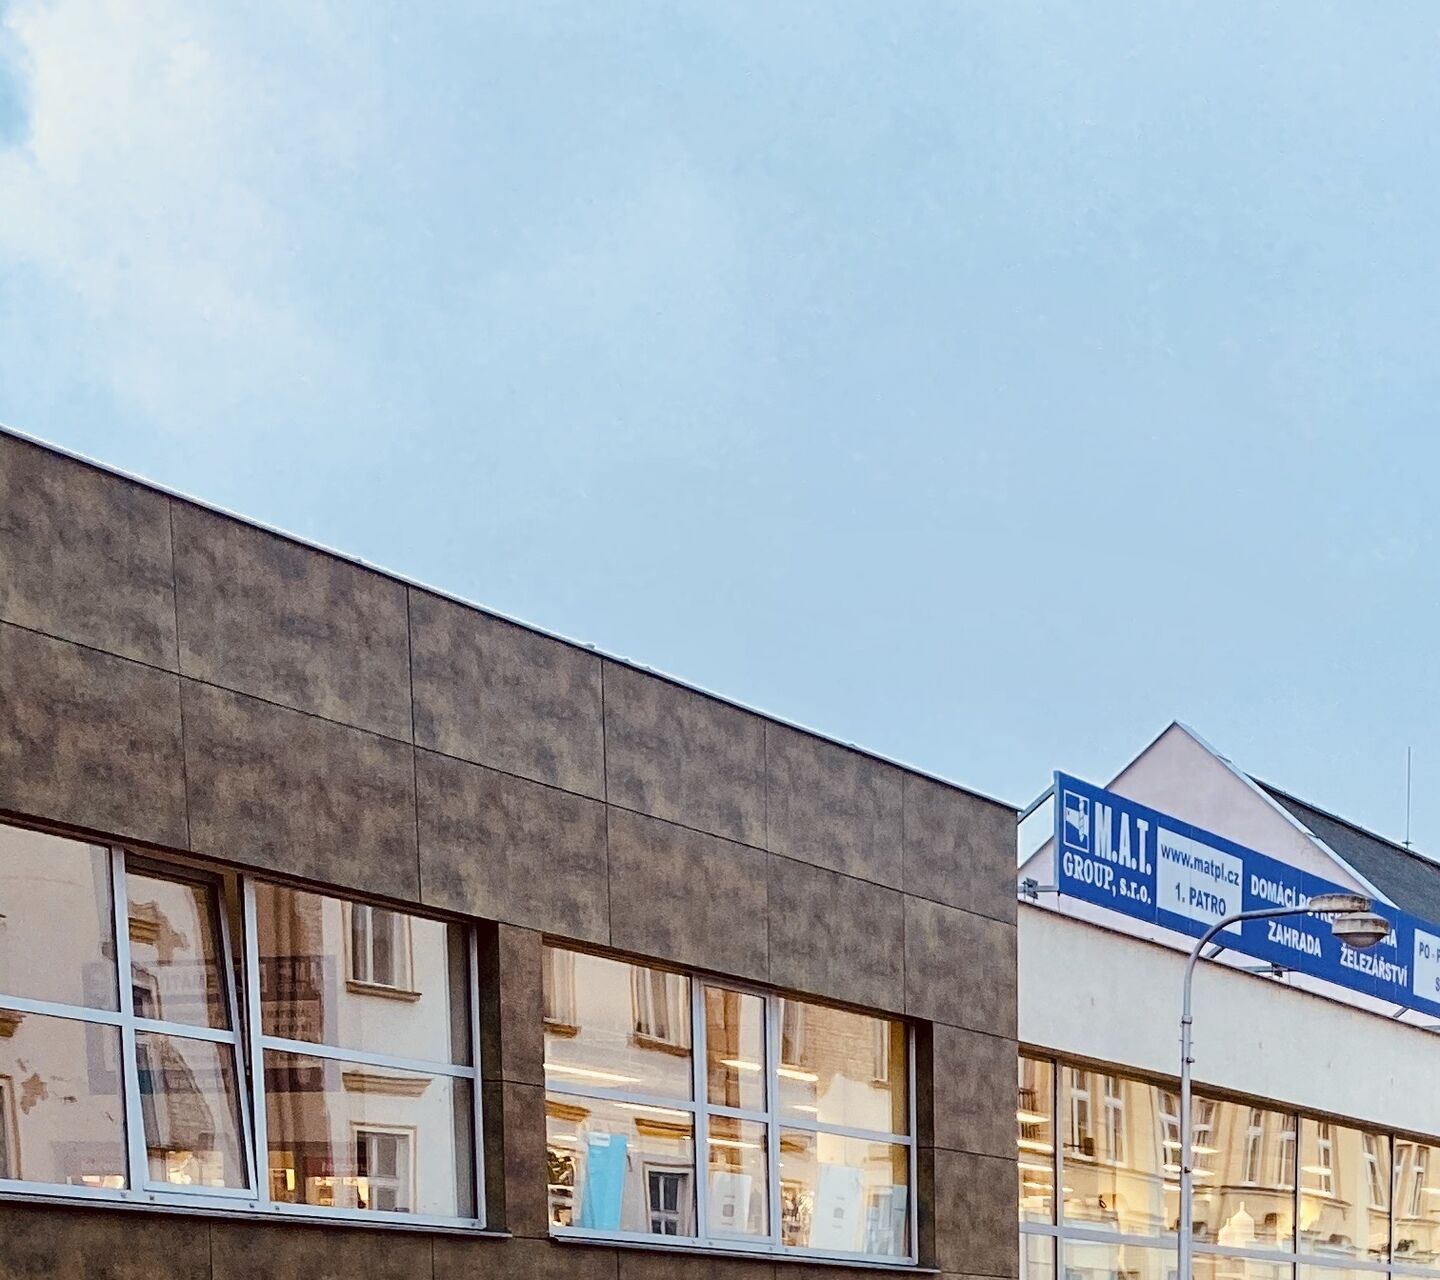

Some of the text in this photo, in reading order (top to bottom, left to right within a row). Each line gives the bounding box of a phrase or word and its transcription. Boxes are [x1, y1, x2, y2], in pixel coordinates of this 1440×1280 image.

[1094, 801, 1153, 876] M.A.T.
[1063, 851, 1152, 904] GROUP, s.r.o.
[1160, 843, 1240, 887] www.matpl.cz
[1175, 882, 1227, 917] 1. PATRO
[1250, 873, 1297, 909] DOMÁCÍ
[1267, 920, 1322, 958] ZAHRADA
[1419, 941, 1430, 959] PO
[1340, 943, 1408, 987] ŽELEZÁŘSTVÍ
